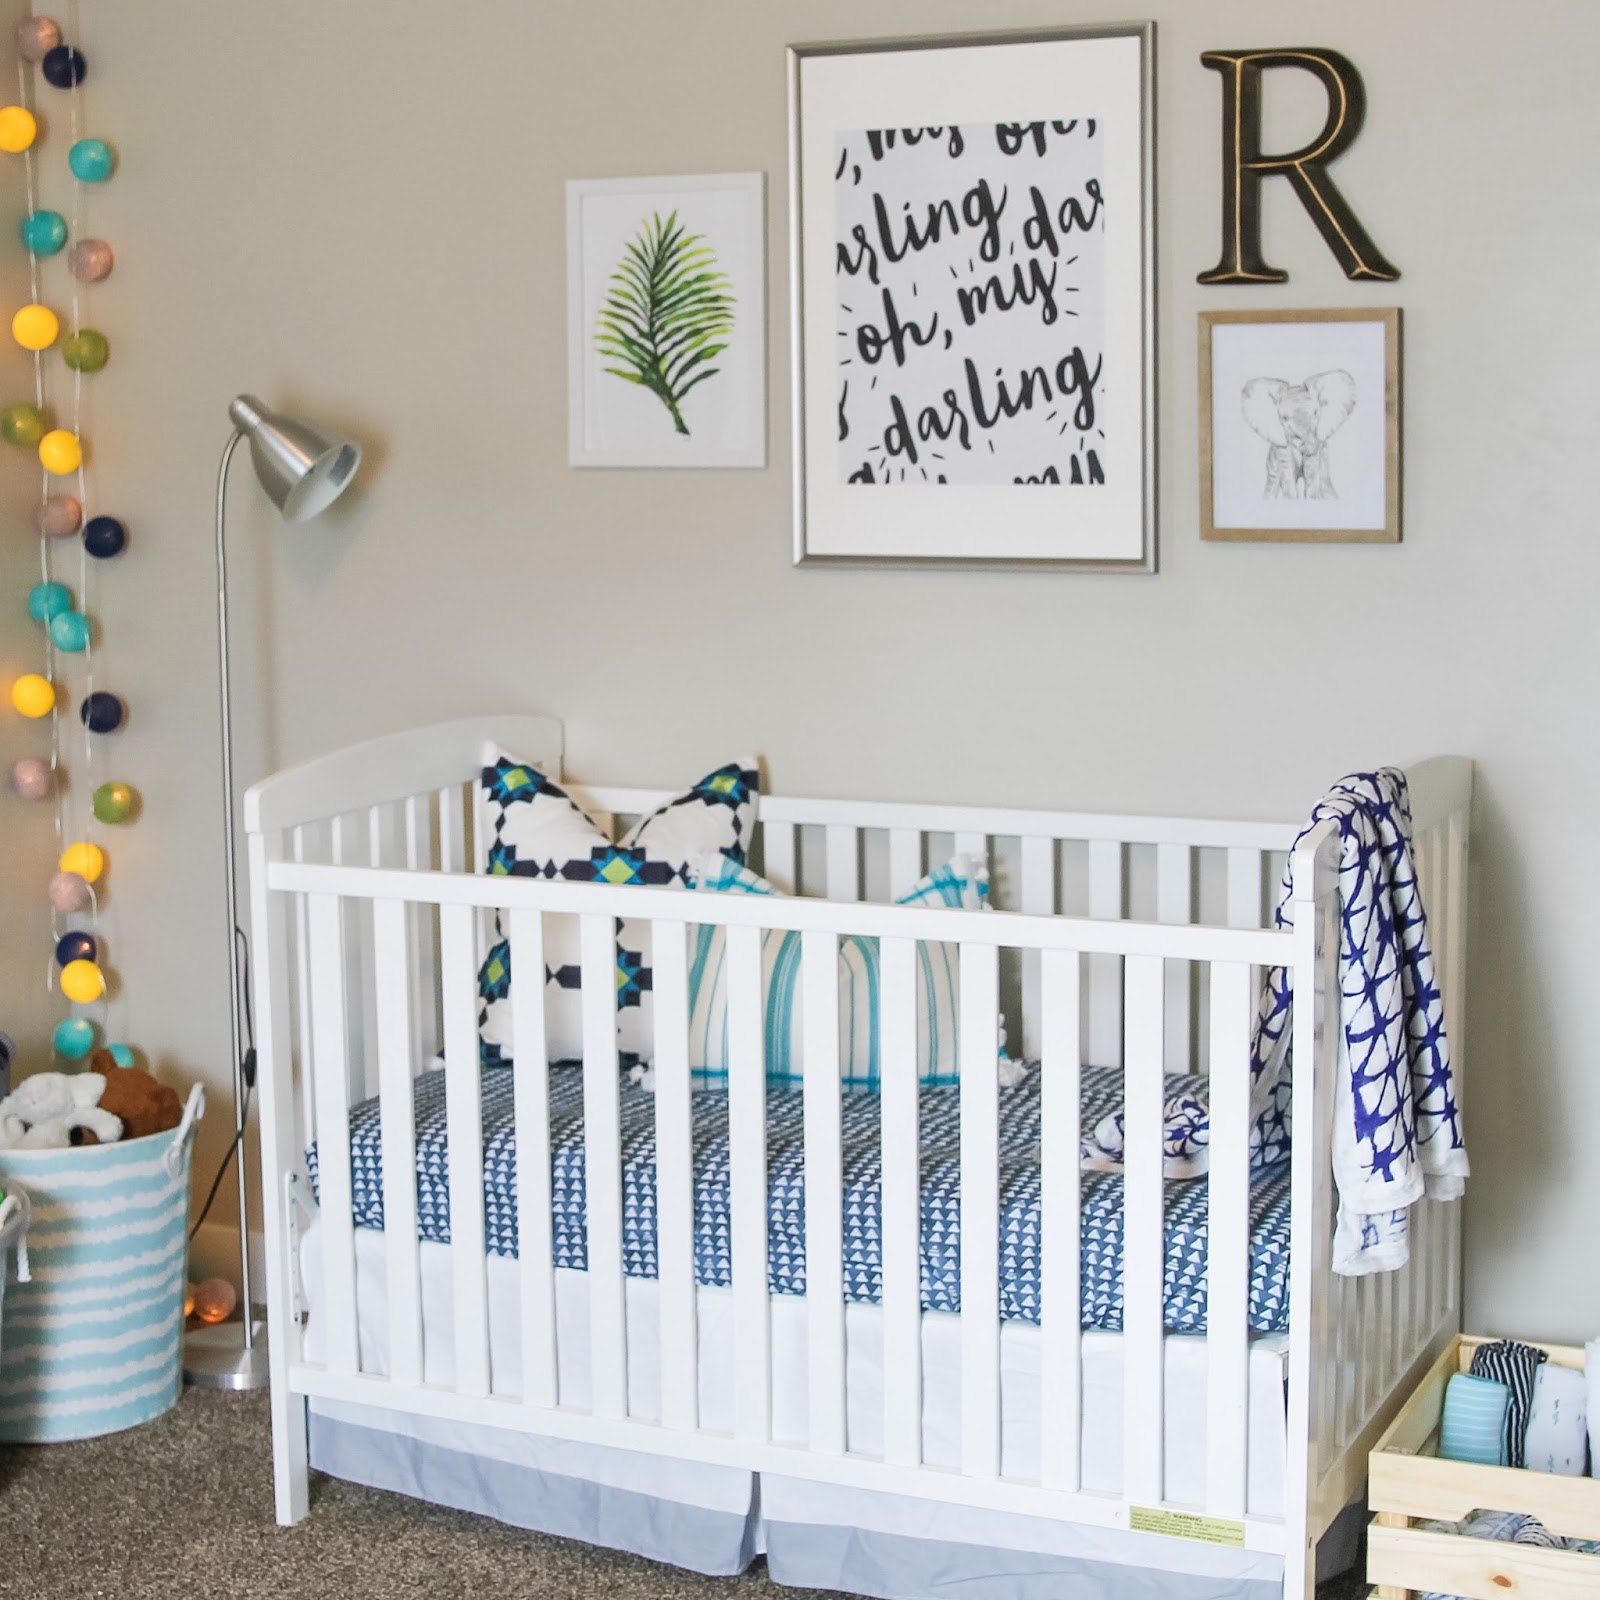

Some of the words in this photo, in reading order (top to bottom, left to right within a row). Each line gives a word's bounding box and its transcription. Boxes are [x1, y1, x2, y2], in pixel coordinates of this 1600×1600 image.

[1197, 48, 1401, 284] R
[857, 287, 953, 367] oh,
[957, 258, 1058, 326] my
[884, 347, 1103, 465] darling
